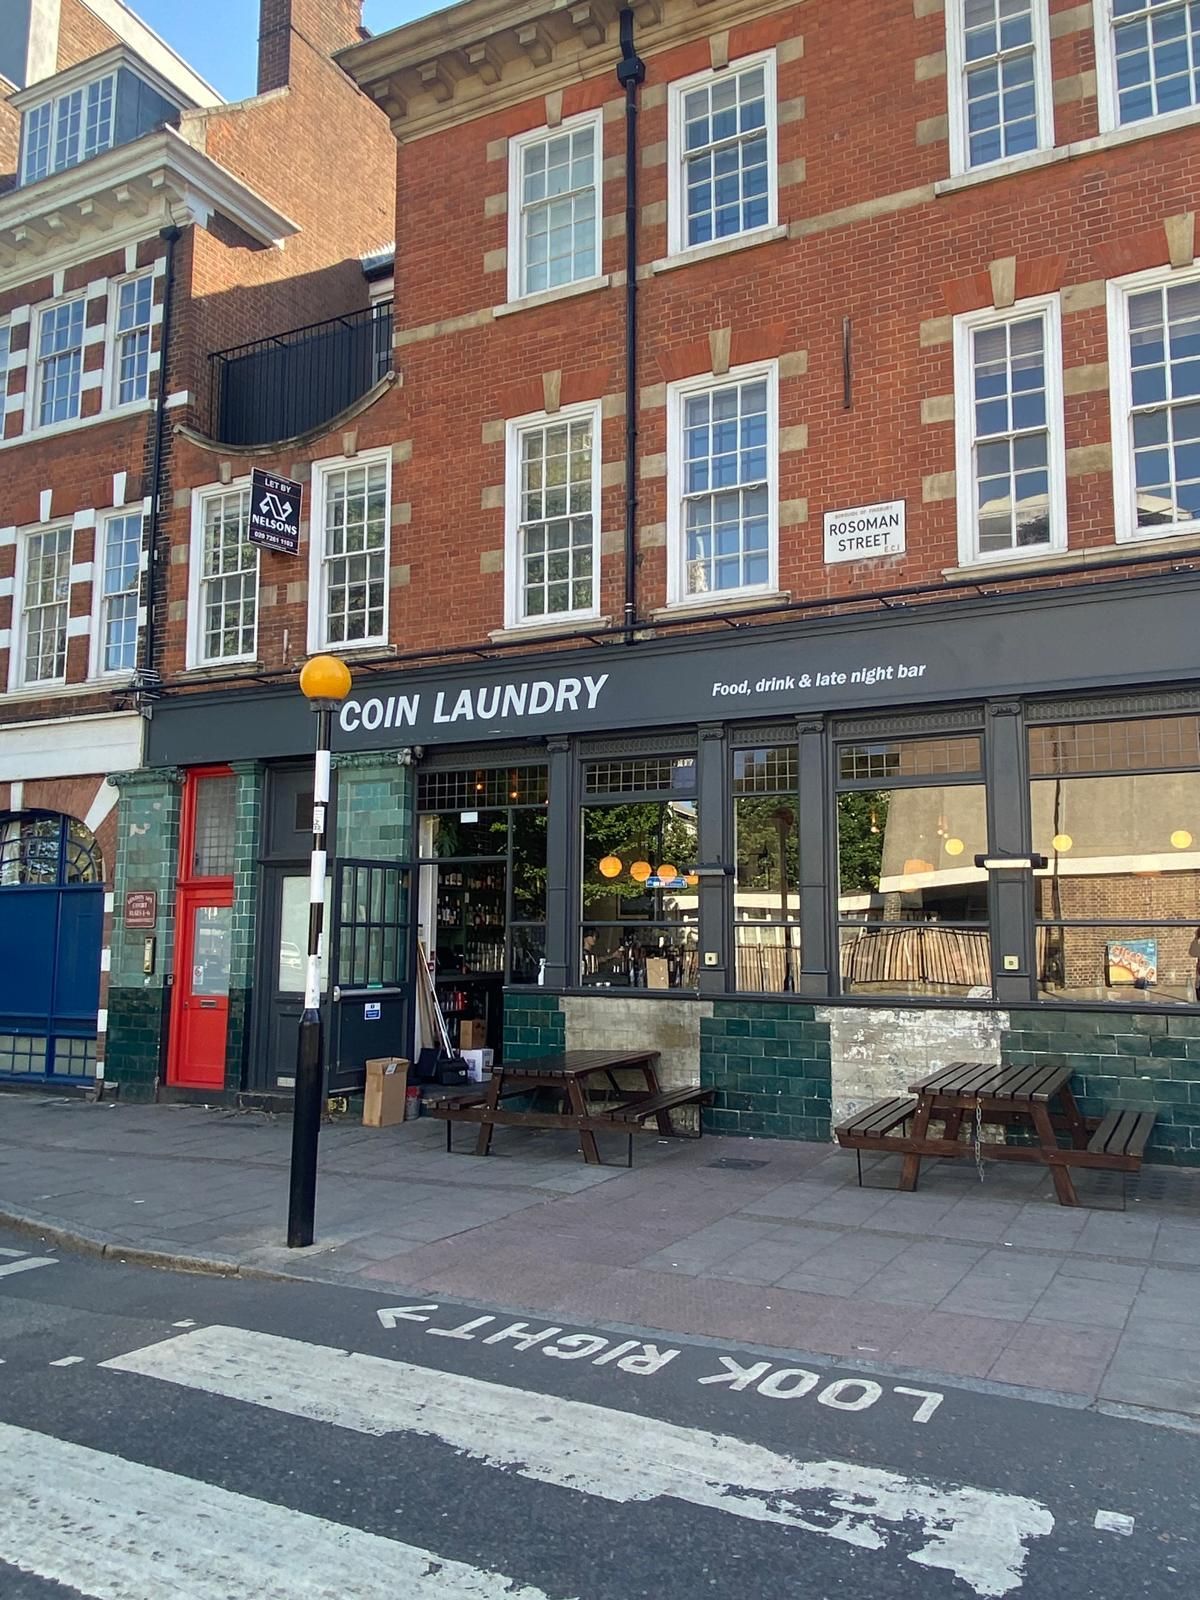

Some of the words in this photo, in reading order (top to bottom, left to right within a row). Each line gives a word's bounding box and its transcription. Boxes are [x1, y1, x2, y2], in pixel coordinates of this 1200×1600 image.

[265, 478, 278, 489] LET
[280, 484, 292, 493] BY
[252, 514, 298, 535] NELSONS
[829, 513, 899, 536] ROSOMAN
[838, 532, 891, 552] STREET
[712, 680, 751, 696] Food,
[755, 675, 795, 692] drink
[798, 674, 812, 688] &
[816, 671, 847, 687] late
[851, 666, 894, 685] night
[897, 664, 926, 679] bar
[339, 694, 420, 732] COIN
[433, 674, 609, 724] LAUNDRY
[426, 1315, 682, 1376] RIGHT
[697, 1356, 944, 1424] LOOK
